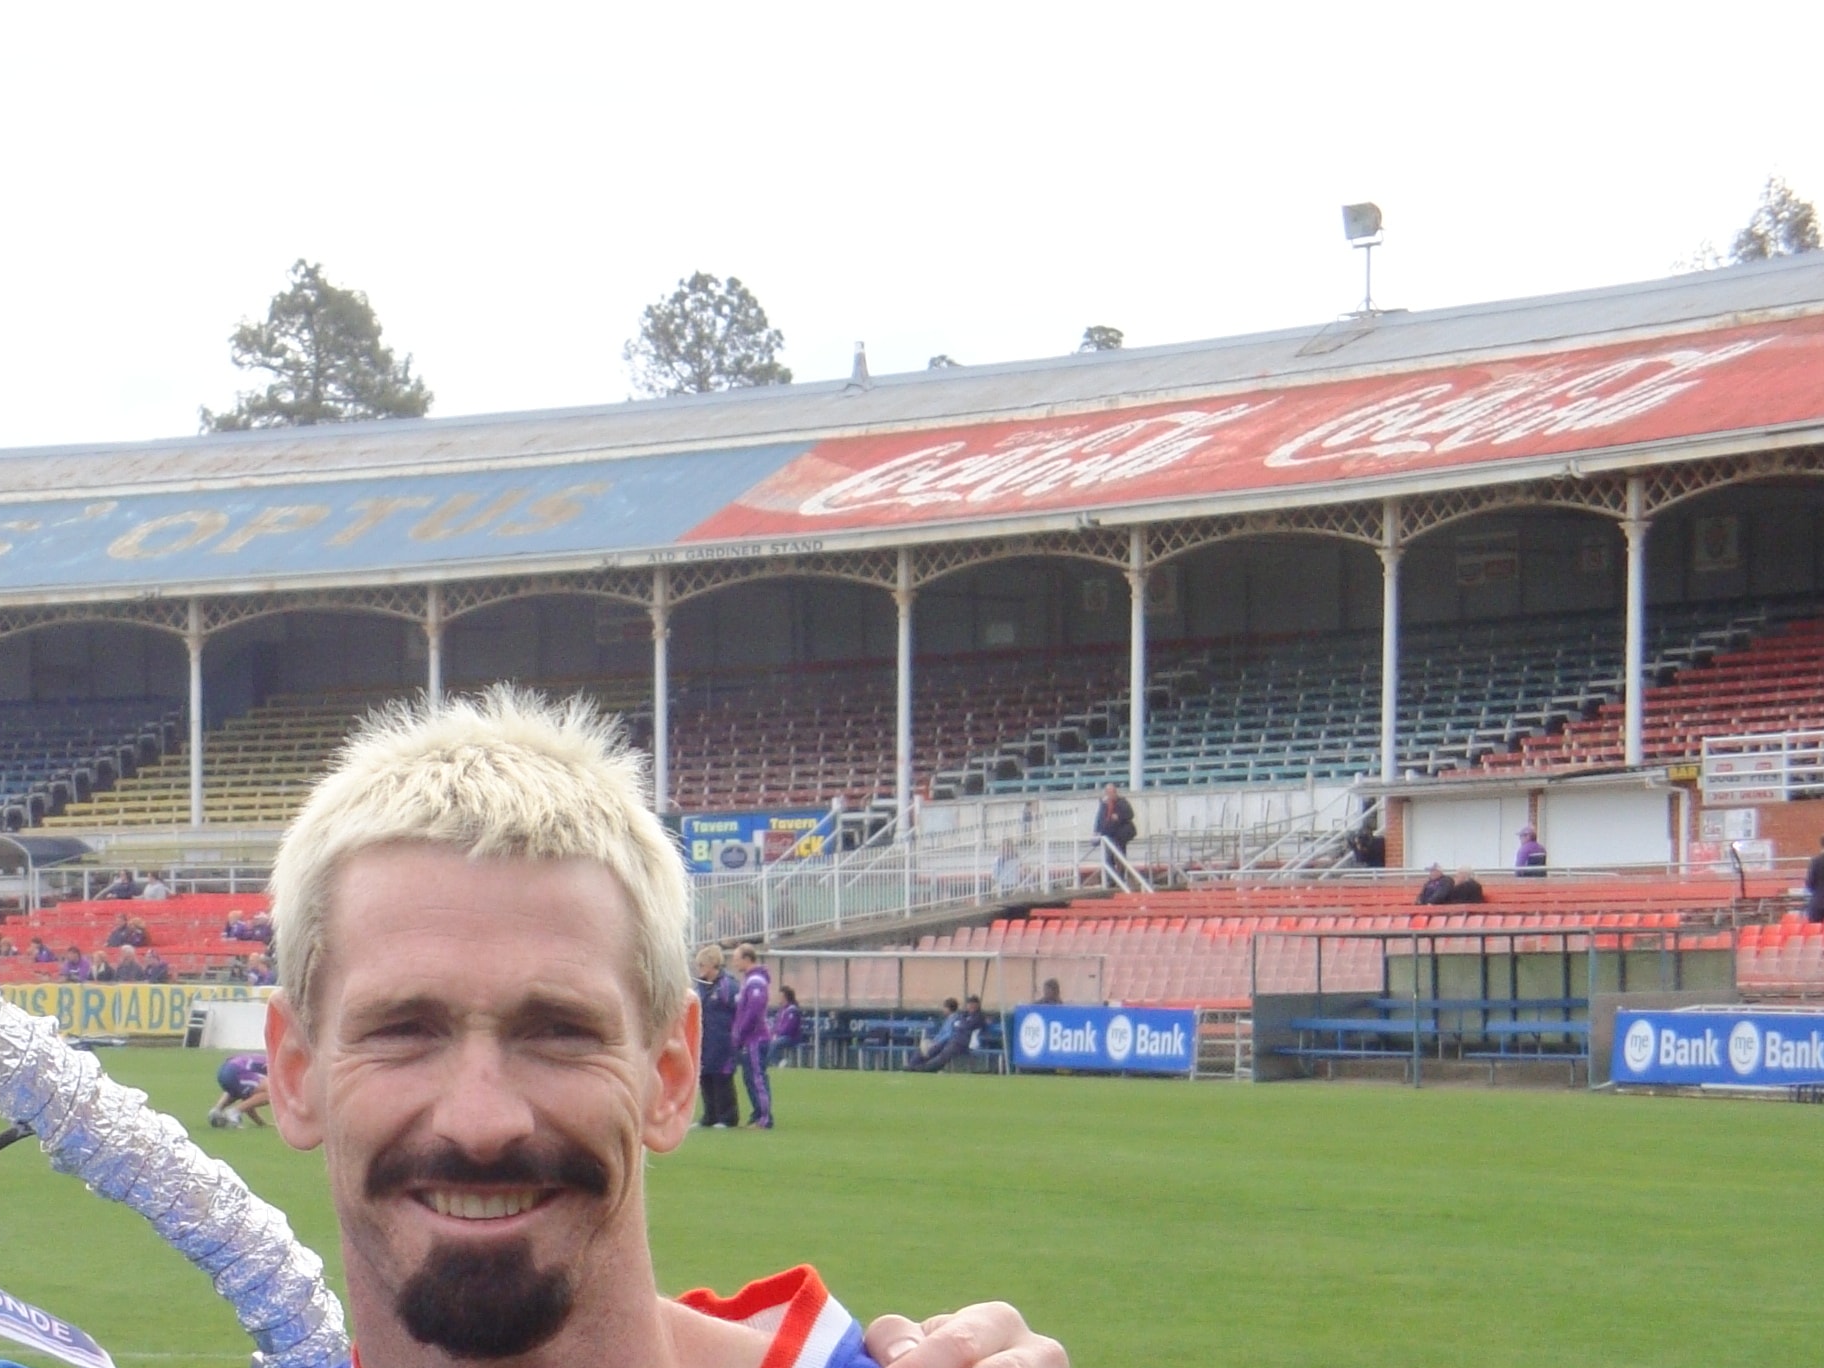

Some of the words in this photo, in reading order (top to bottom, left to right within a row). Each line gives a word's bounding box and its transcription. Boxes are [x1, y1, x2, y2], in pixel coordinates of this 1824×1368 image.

[107, 481, 613, 560] OPTUS
[685, 544, 761, 560] GARDINER
[770, 540, 824, 555] STAND
[692, 820, 739, 833] Tavern
[769, 818, 818, 831] Tavern
[1049, 1020, 1096, 1052] Bank
[1136, 1022, 1184, 1055] Bank
[1660, 1028, 1720, 1066] Bank
[1765, 1031, 1824, 1068] Bank
